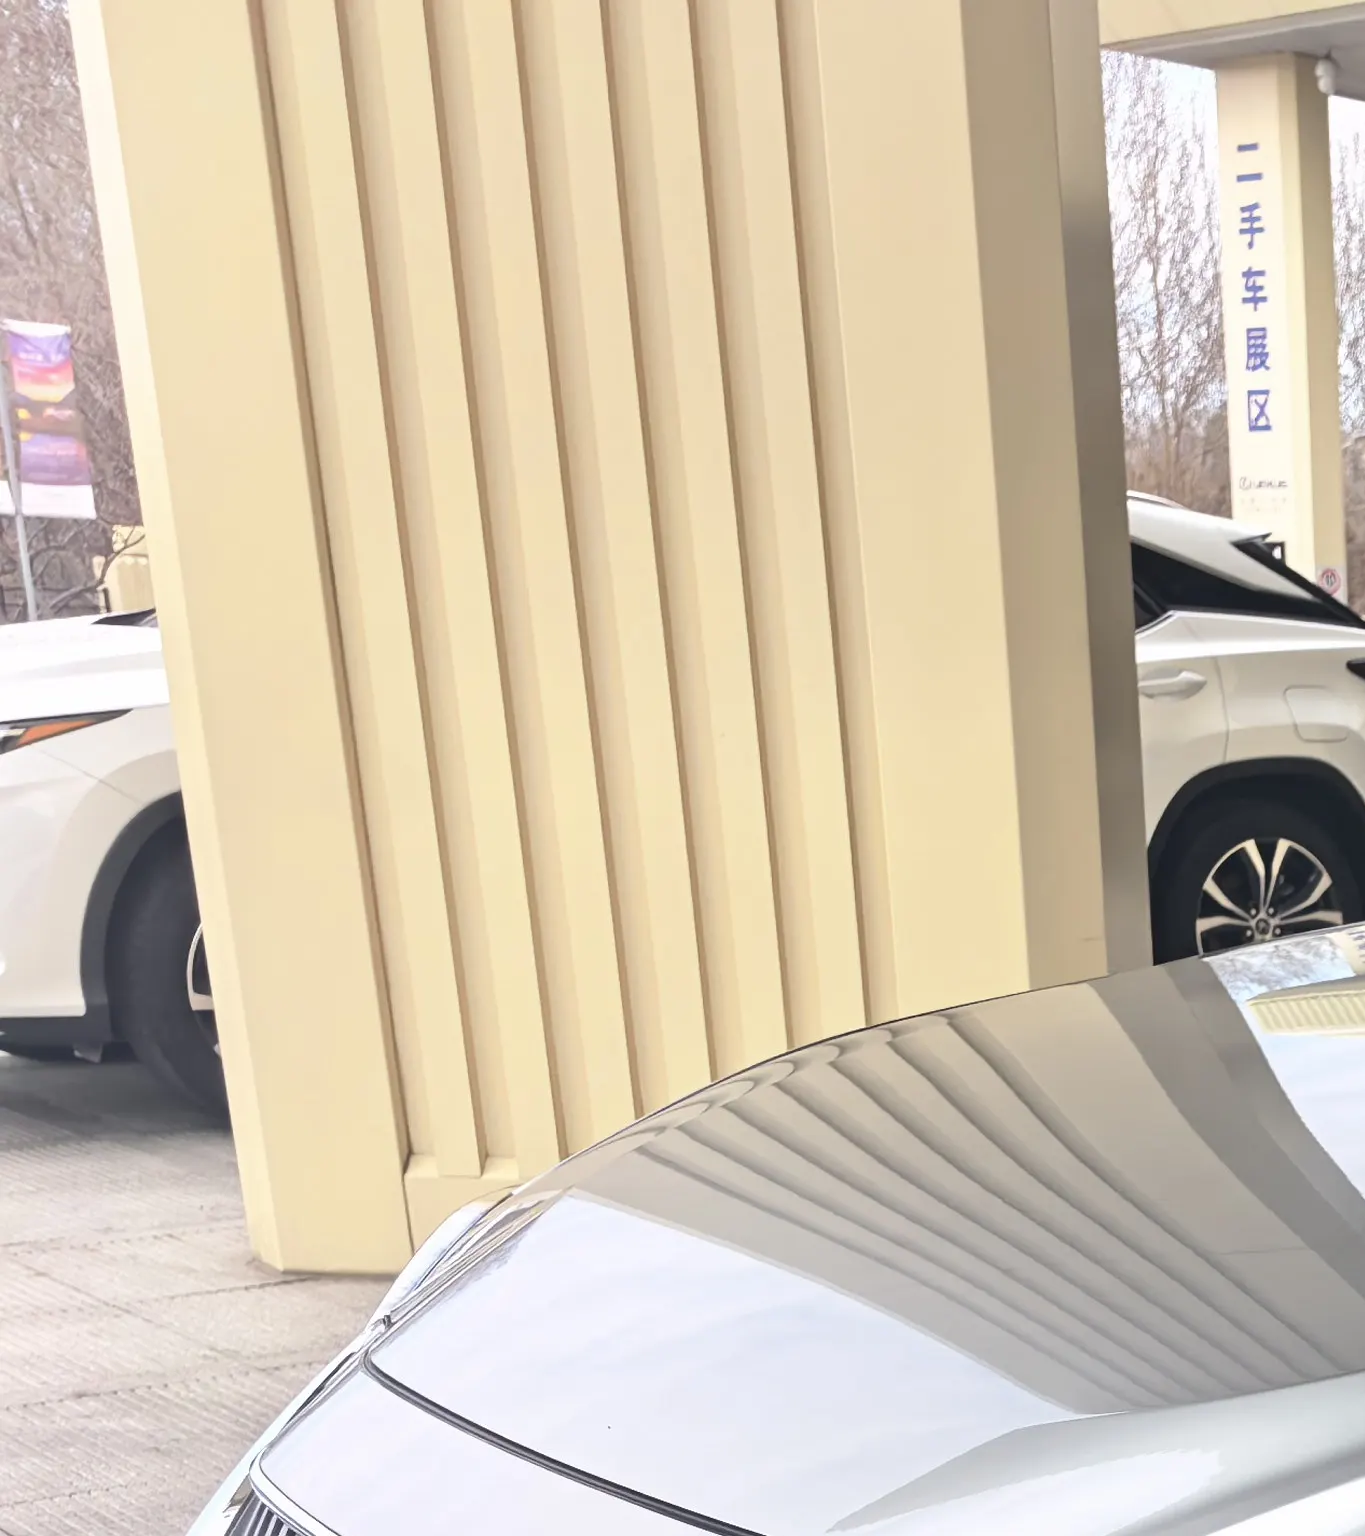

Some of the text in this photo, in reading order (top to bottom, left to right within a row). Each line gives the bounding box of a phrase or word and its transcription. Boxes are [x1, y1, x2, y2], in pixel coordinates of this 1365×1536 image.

[1235, 141, 1273, 432] 二手车展区
